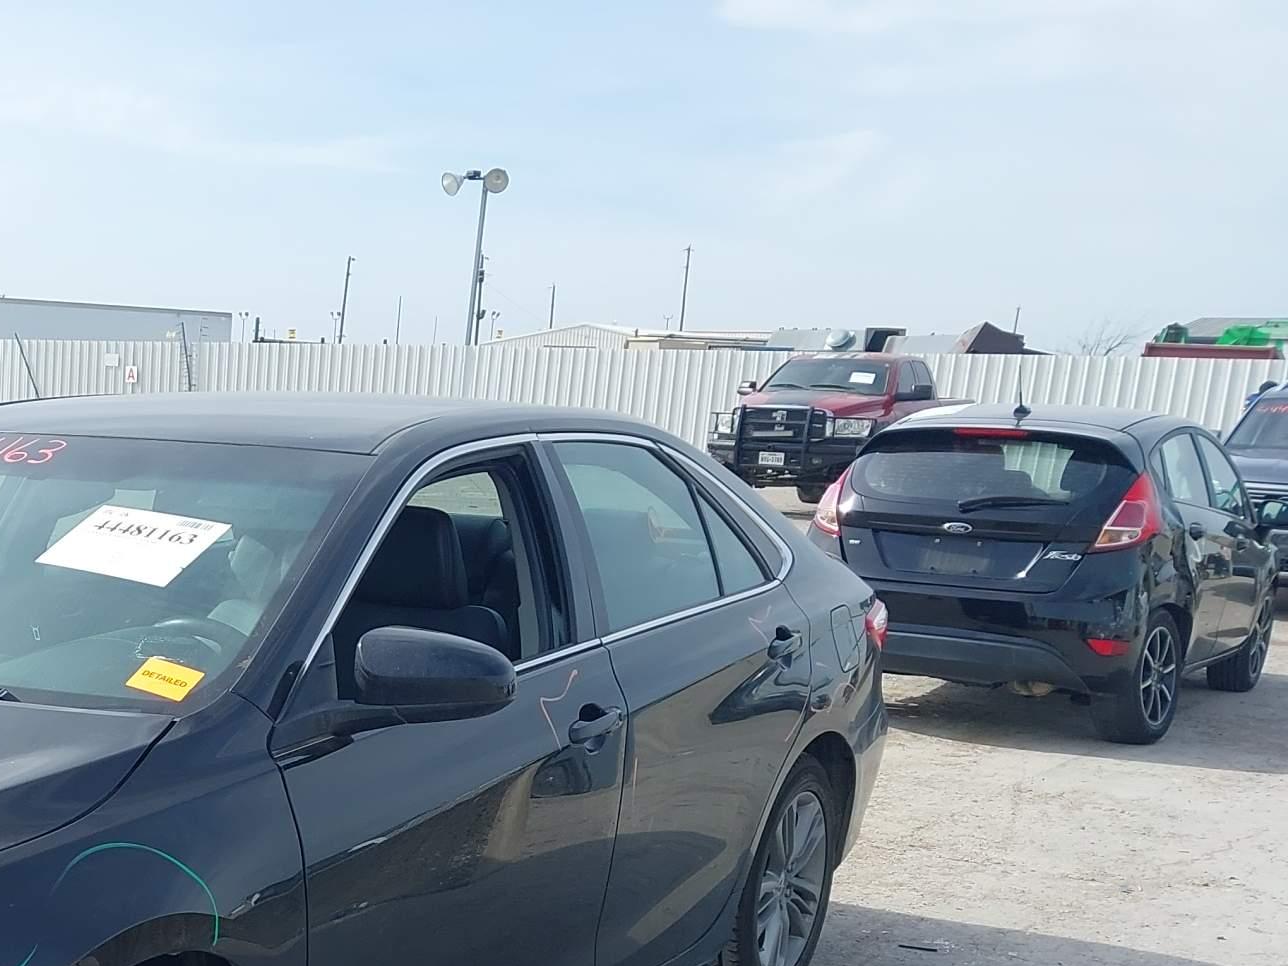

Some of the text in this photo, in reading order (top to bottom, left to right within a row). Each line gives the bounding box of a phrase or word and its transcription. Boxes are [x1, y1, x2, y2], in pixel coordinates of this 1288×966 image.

[127, 367, 136, 381] A
[94, 519, 199, 545] 44481163
[142, 669, 188, 688] DETAILED
